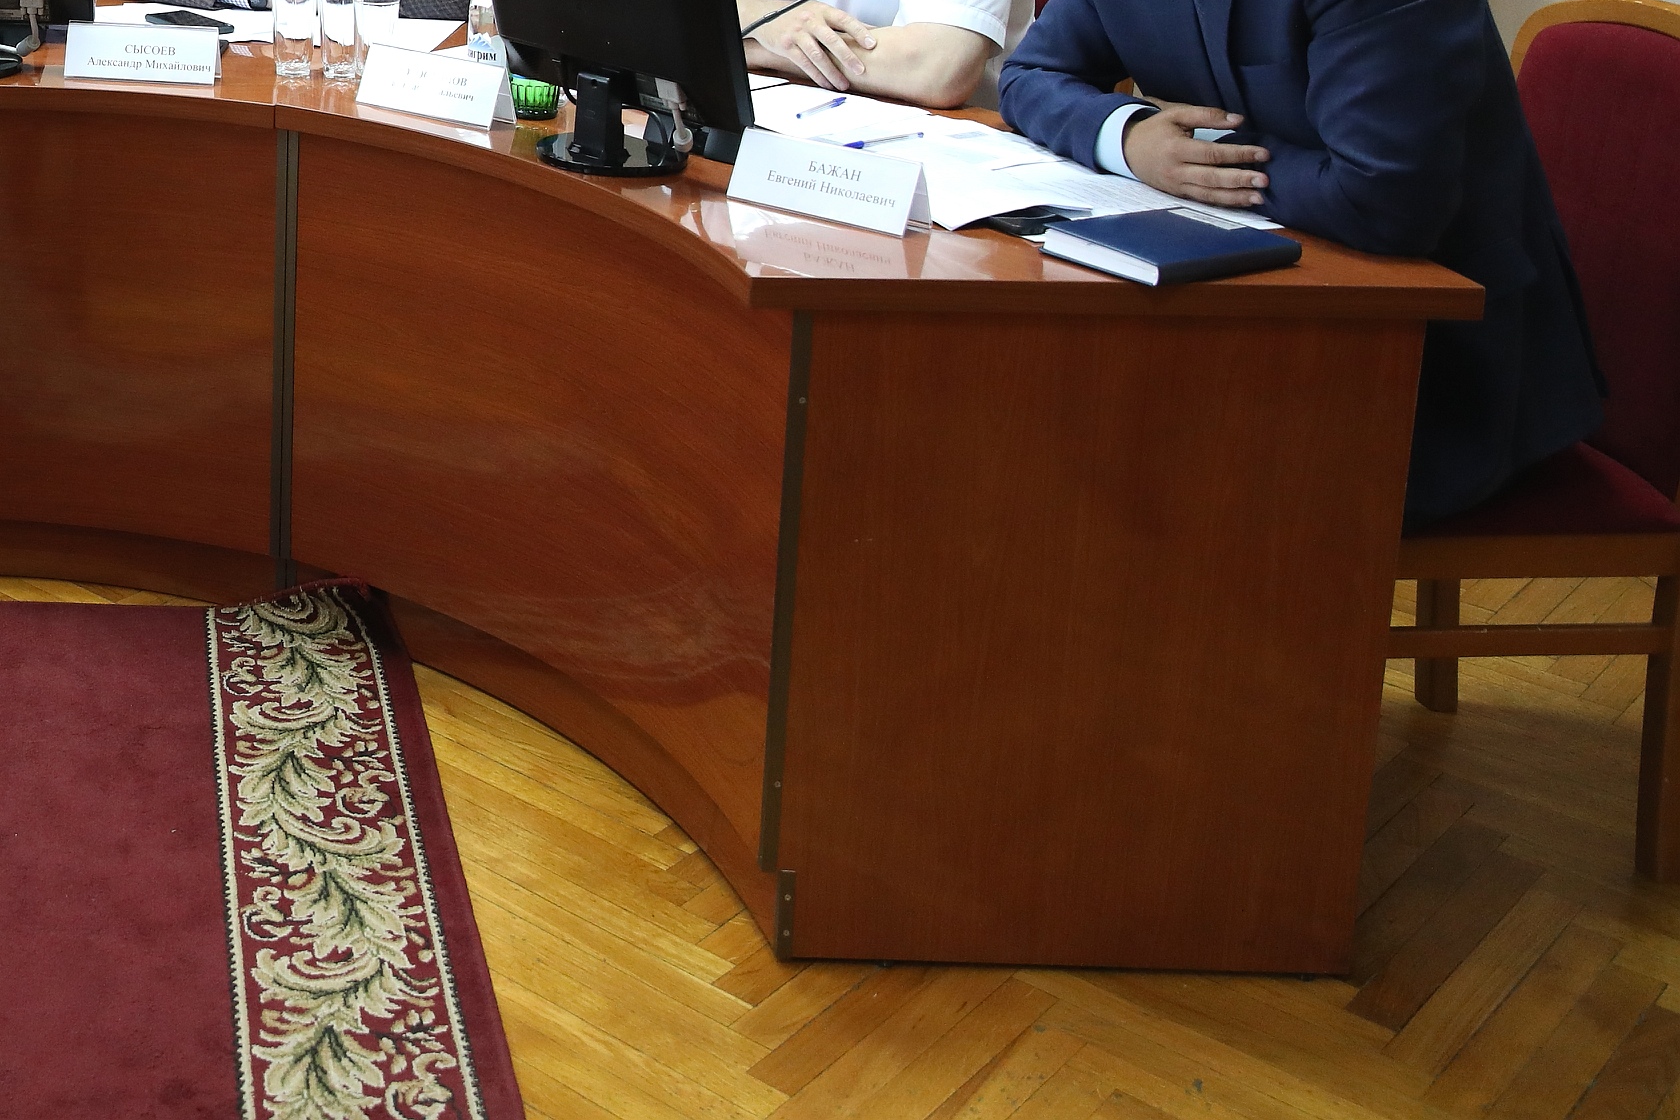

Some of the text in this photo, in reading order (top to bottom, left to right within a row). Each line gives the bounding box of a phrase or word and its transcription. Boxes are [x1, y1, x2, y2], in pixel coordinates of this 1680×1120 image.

[124, 44, 176, 56] СЫСОЕВ
[87, 56, 211, 73] Александр Михайлович
[808, 160, 862, 182] БАЖАН
[767, 169, 896, 208] Евгений Николаевич
